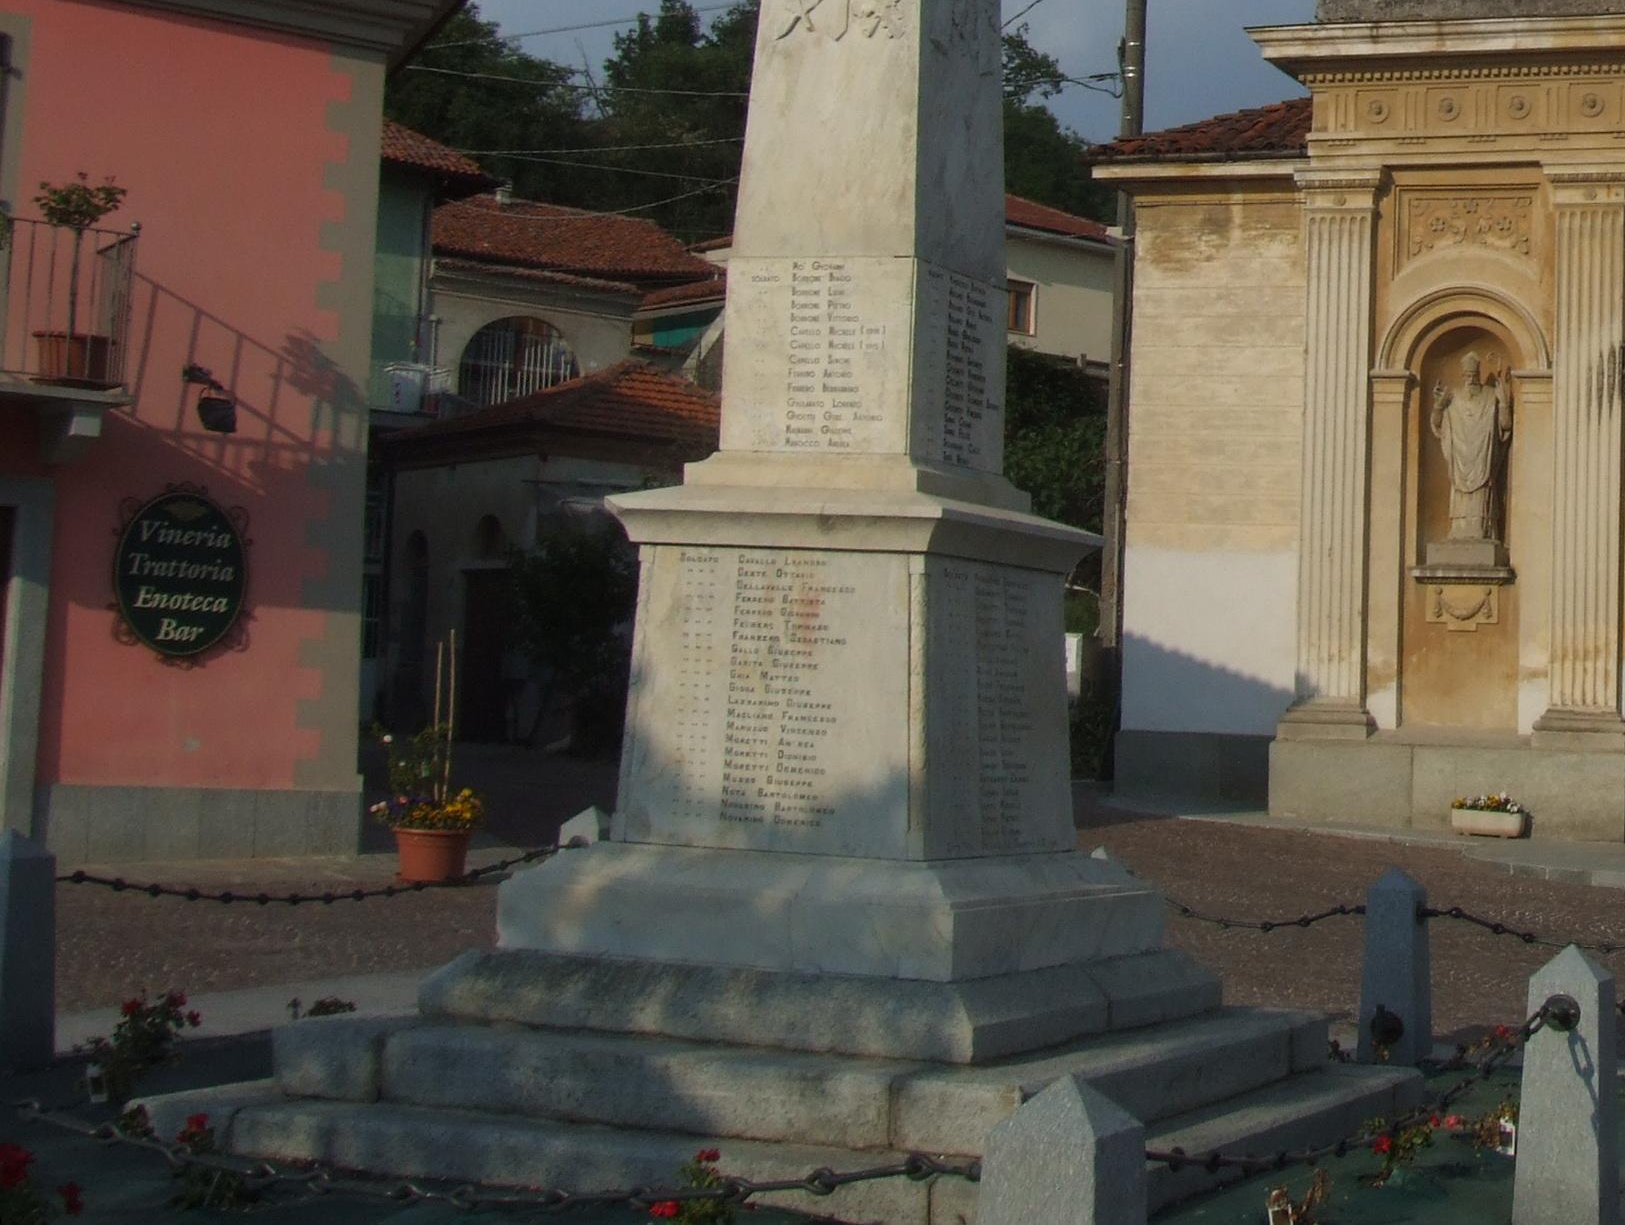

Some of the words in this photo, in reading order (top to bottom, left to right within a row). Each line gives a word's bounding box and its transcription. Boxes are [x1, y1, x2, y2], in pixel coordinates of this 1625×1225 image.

[139, 519, 232, 549] Vineria
[129, 553, 235, 583] Trattoria
[133, 585, 230, 614] Enoteca
[156, 618, 204, 642] Bar
